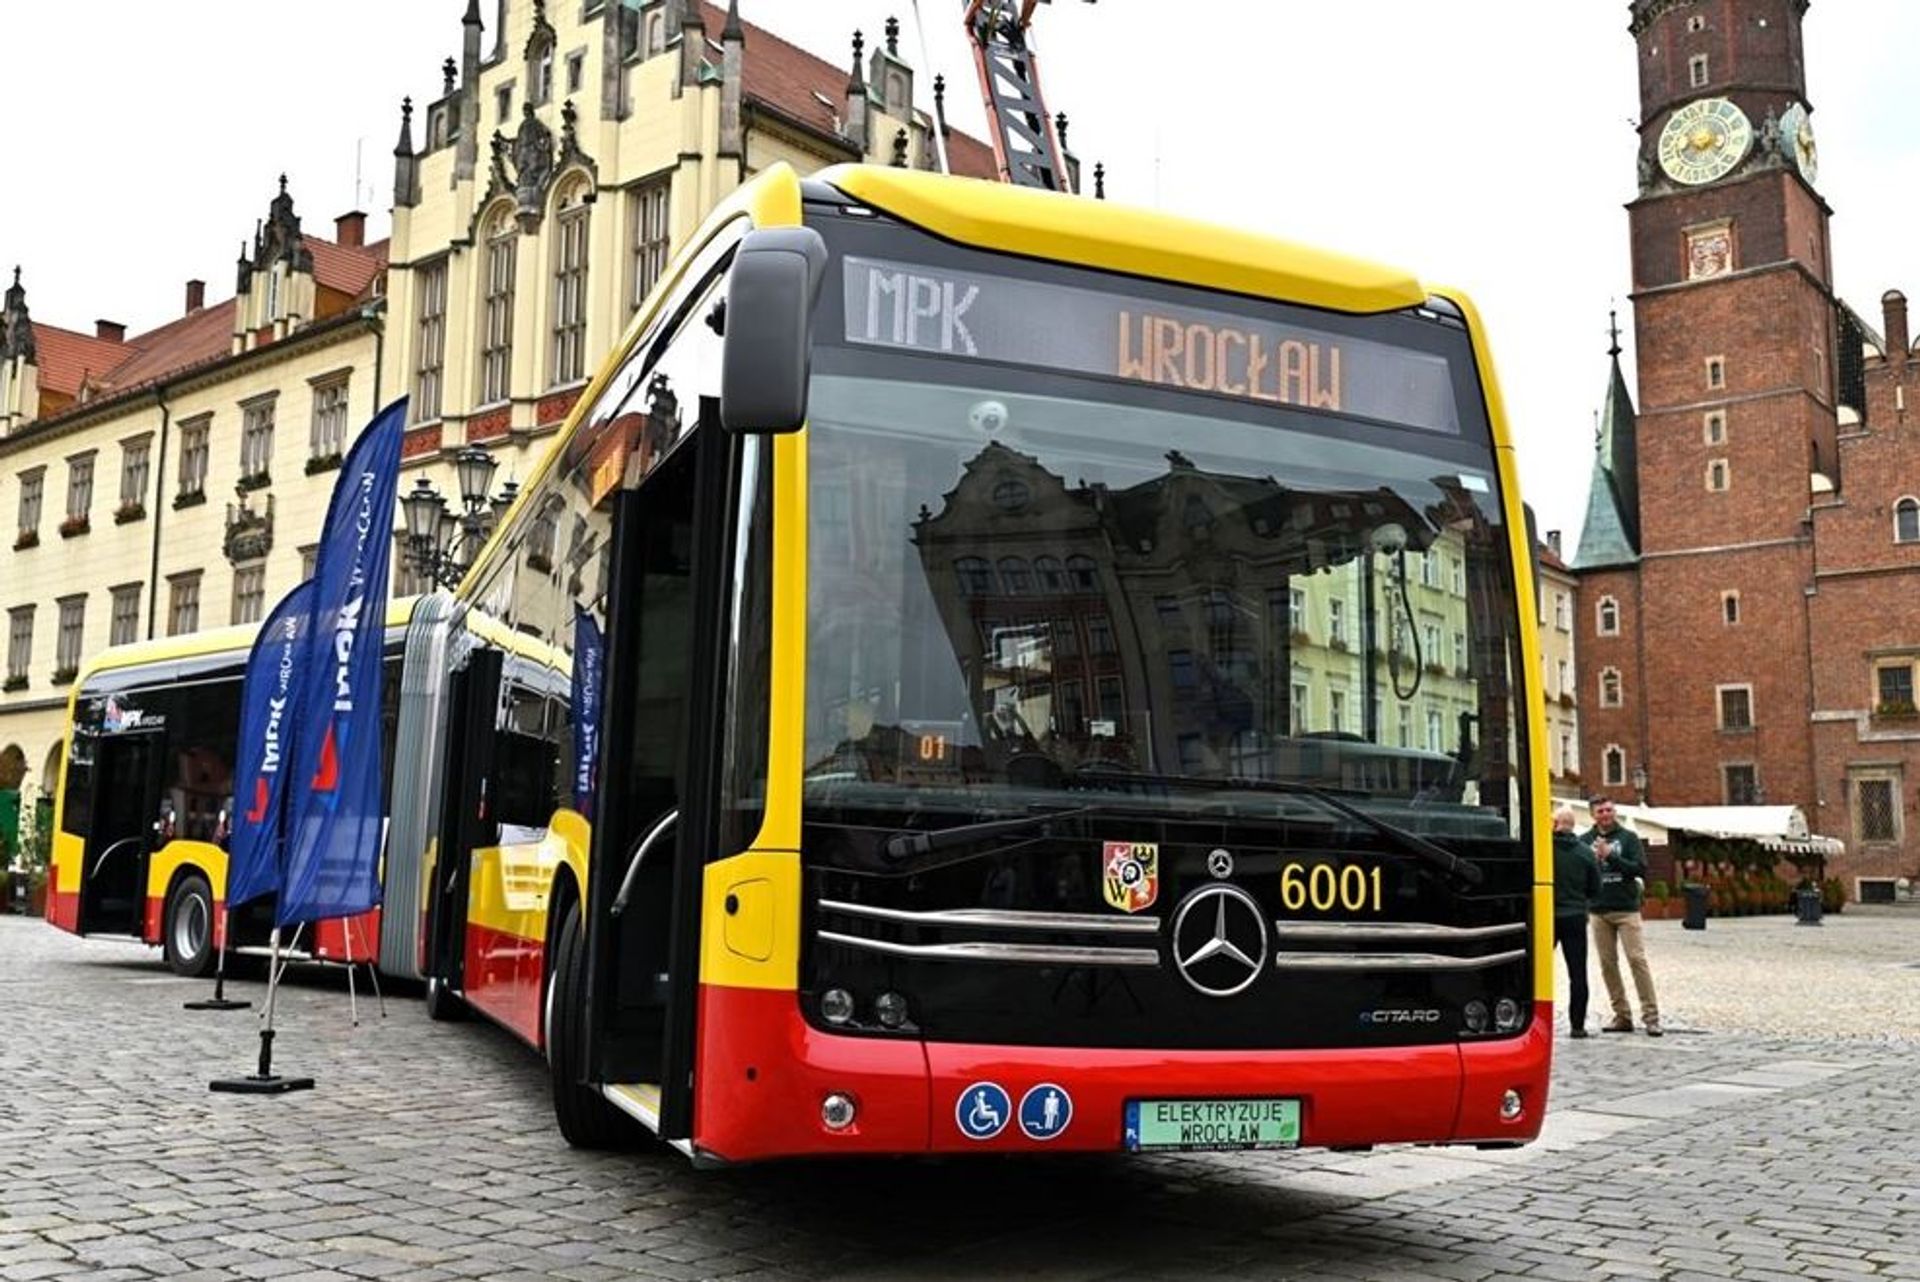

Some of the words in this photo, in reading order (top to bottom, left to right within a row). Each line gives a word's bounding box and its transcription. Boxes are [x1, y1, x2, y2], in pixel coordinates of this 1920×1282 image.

[867, 267, 979, 356] MPK
[1118, 311, 1340, 411] WROCŁAW
[920, 735, 945, 760] 01
[1281, 863, 1380, 911] 6001
[1157, 1103, 1282, 1122] ELEKTRYZUJĘ
[1181, 1124, 1260, 1143] WROCŁAW
